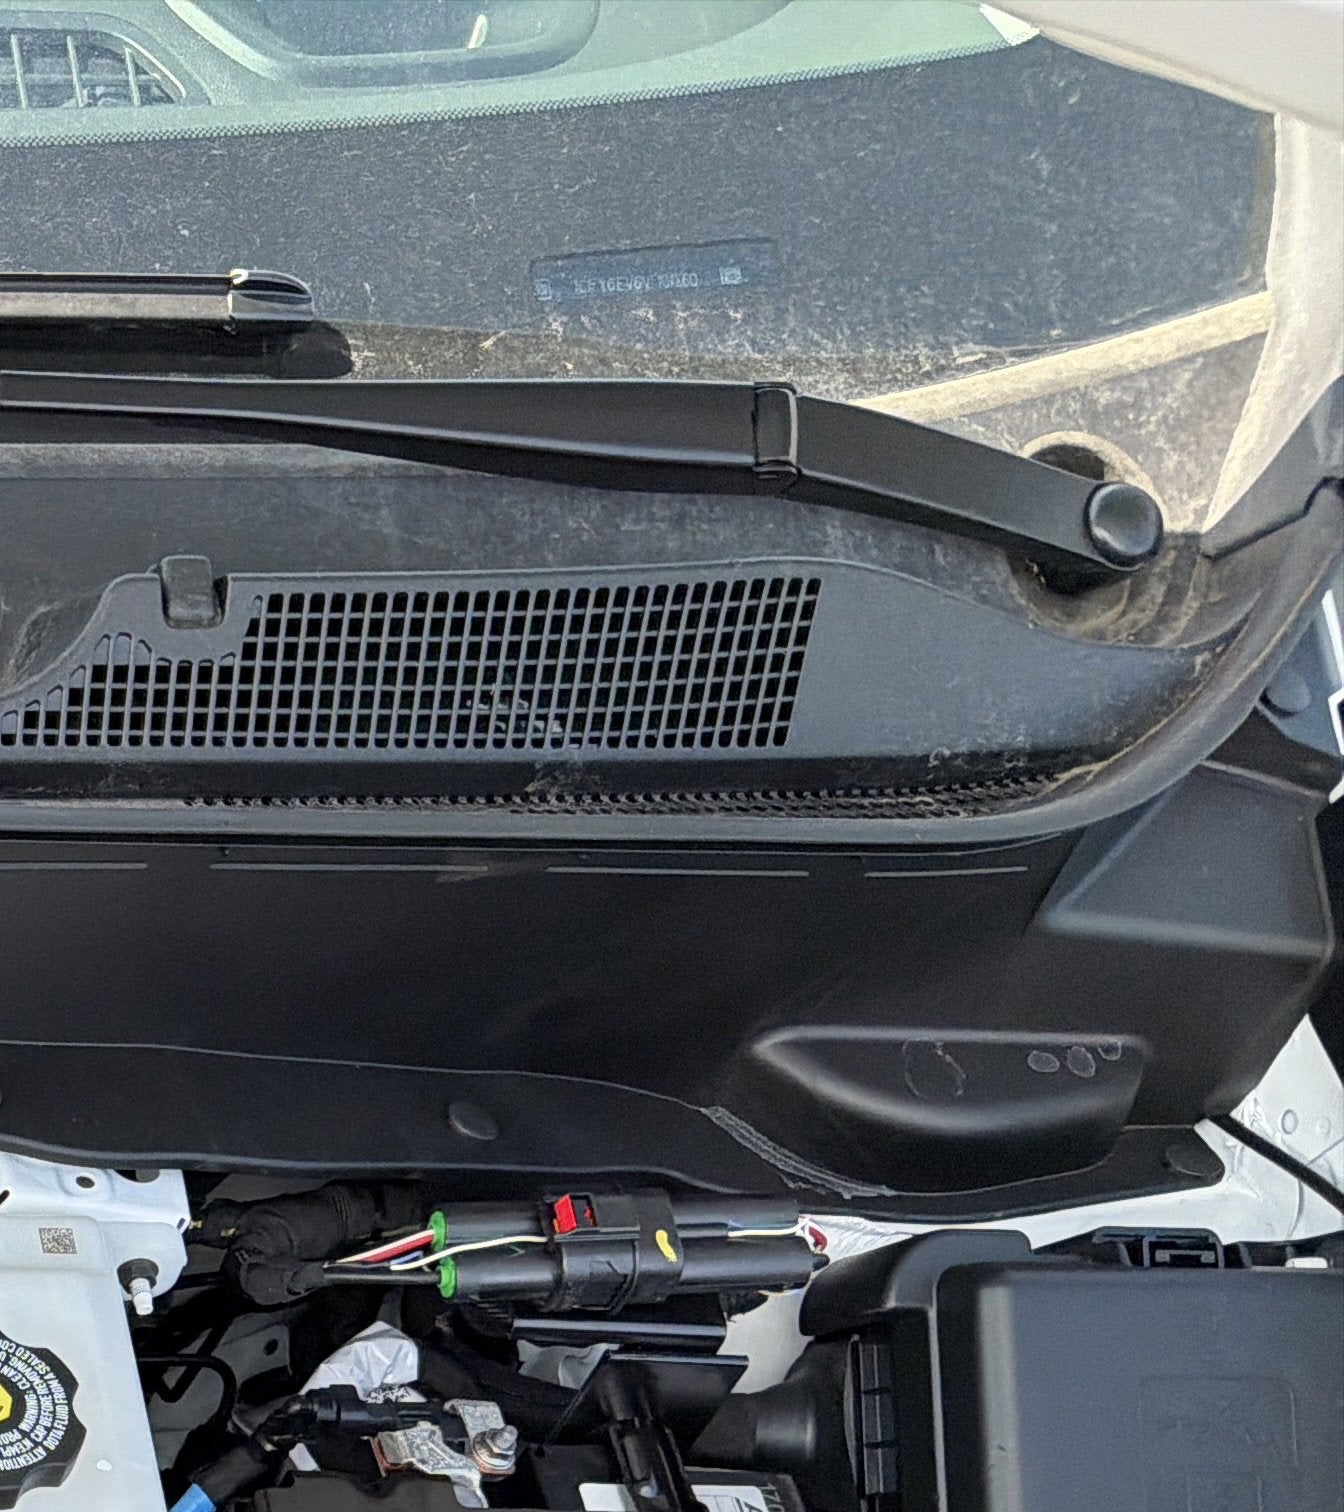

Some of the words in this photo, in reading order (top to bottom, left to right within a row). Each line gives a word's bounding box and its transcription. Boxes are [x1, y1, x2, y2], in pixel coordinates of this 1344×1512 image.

[15, 1346, 50, 1374] SEALED
[0, 1364, 30, 1390] CLEAN
[44, 1372, 56, 1380] A
[47, 1379, 68, 1404] FROM
[38, 1394, 54, 1427] BEFORE
[54, 1404, 68, 1430] FLUID
[30, 1424, 48, 1442] CAP
